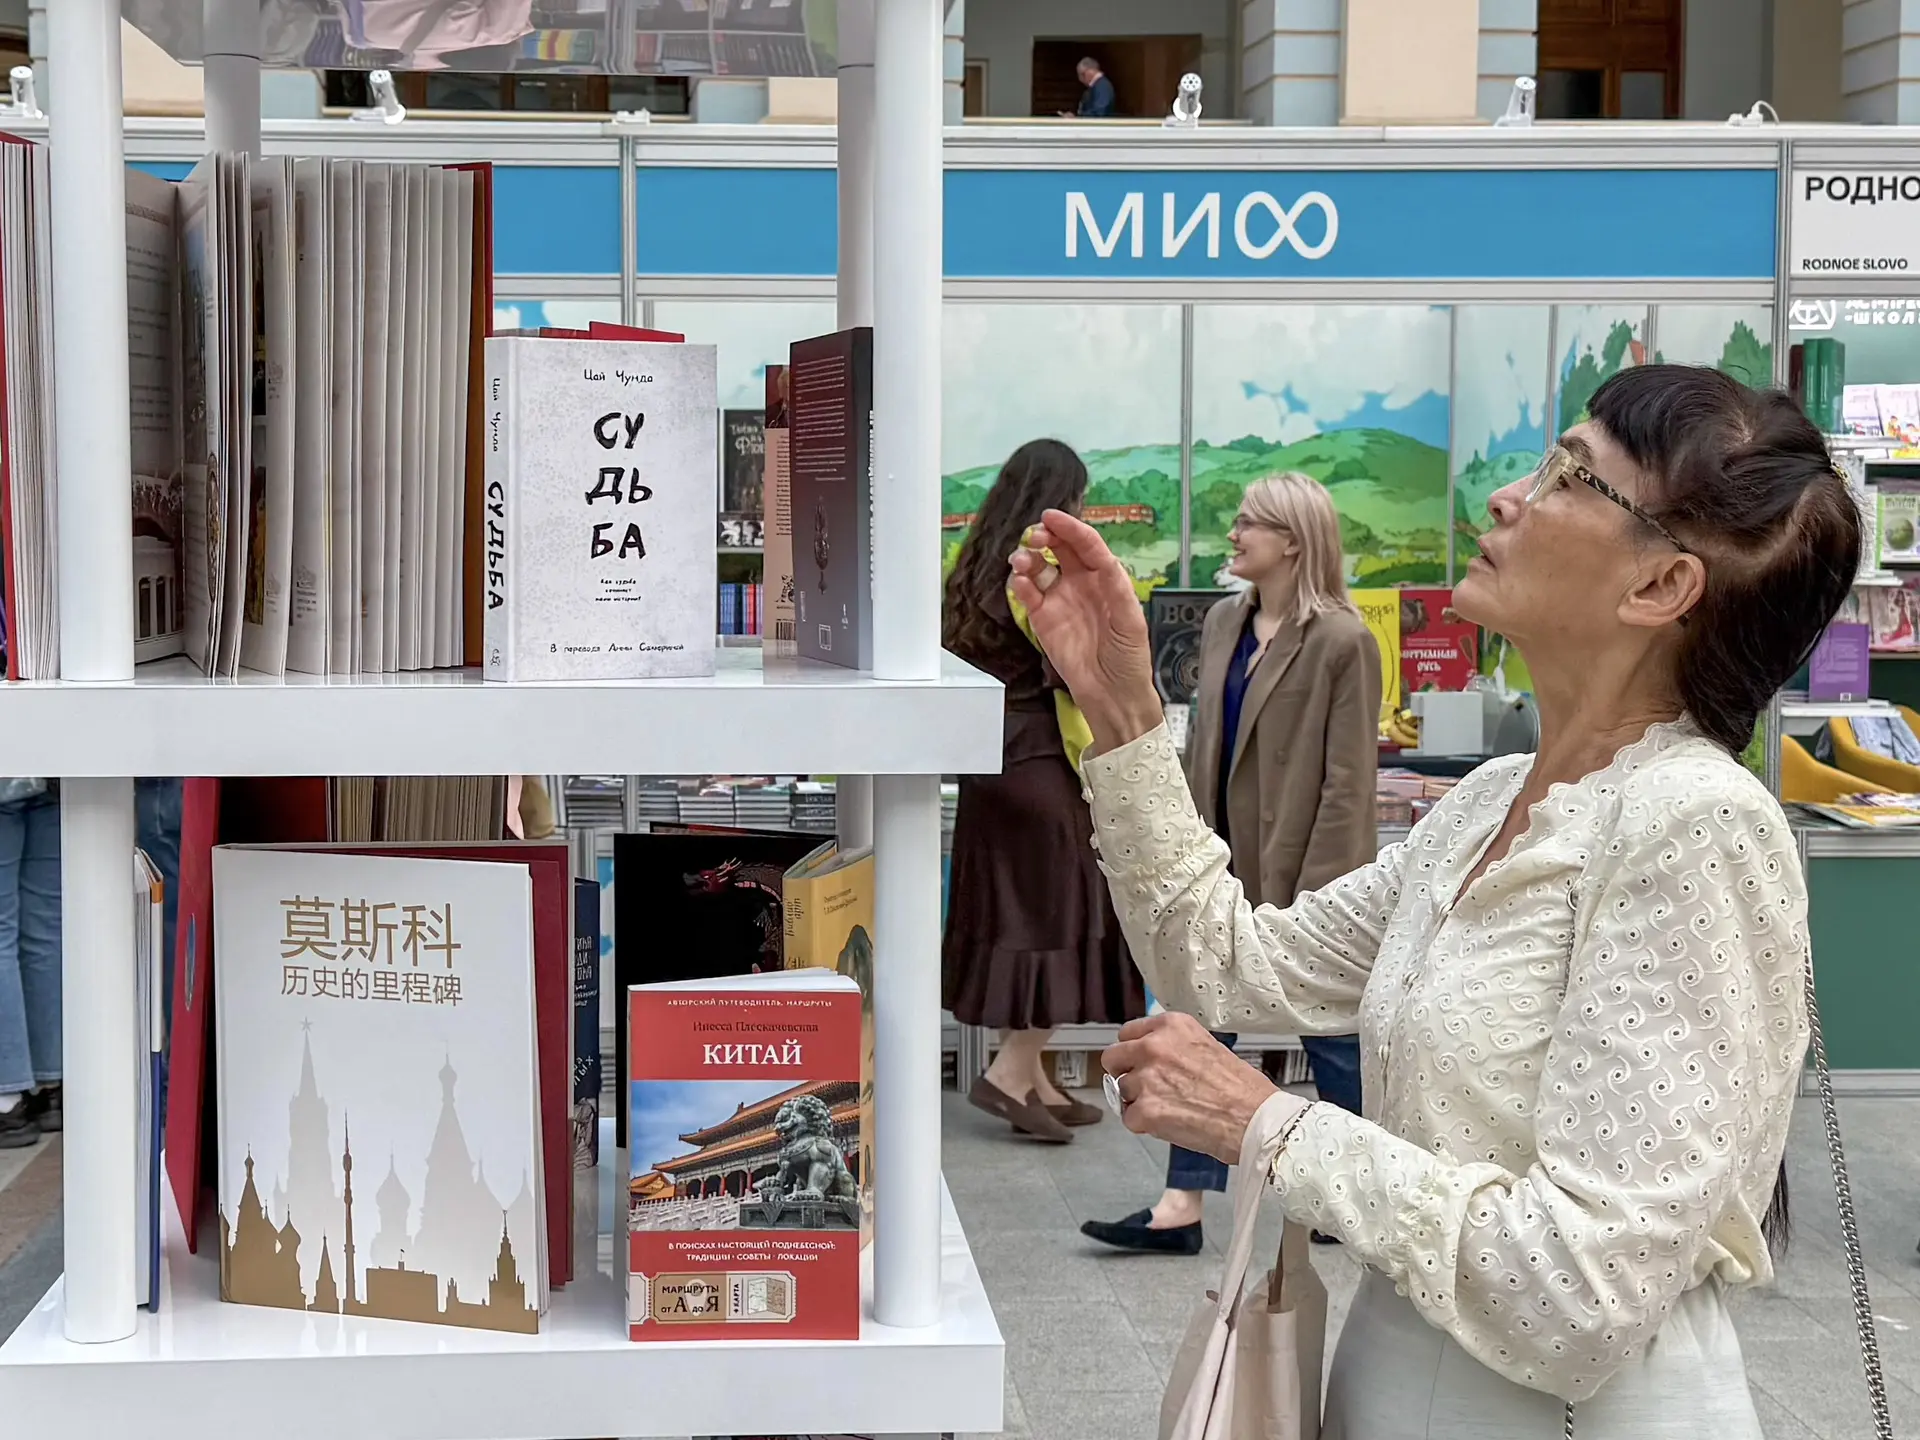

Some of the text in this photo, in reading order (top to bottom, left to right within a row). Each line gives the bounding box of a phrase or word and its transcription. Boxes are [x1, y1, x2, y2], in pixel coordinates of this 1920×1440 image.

[1805, 176, 1920, 205] РОДНО
[1802, 258, 1908, 270] RODNOE SLOVO
[584, 369, 653, 386] Цай Чунда
[593, 412, 645, 450] СУ
[585, 467, 653, 505] ДЬ
[487, 481, 504, 610] СУДЬБА
[590, 522, 647, 560] БА
[550, 643, 557, 653] В
[280, 895, 462, 969] 莫斯科
[281, 965, 463, 1007] 历史的里程碑
[703, 1039, 803, 1065] КИТАЙ
[675, 1242, 716, 1250] ПОИСКАХ
[718, 1240, 770, 1250] НАСТОЯЩЕЙ
[686, 1253, 818, 1261] ТРАДИЦИИ СОВЕТЫ ЛОКАЦИИ
[662, 1285, 719, 1294] МАРШРУТЫ
[673, 1296, 688, 1313] А
[706, 1295, 719, 1313] Я
